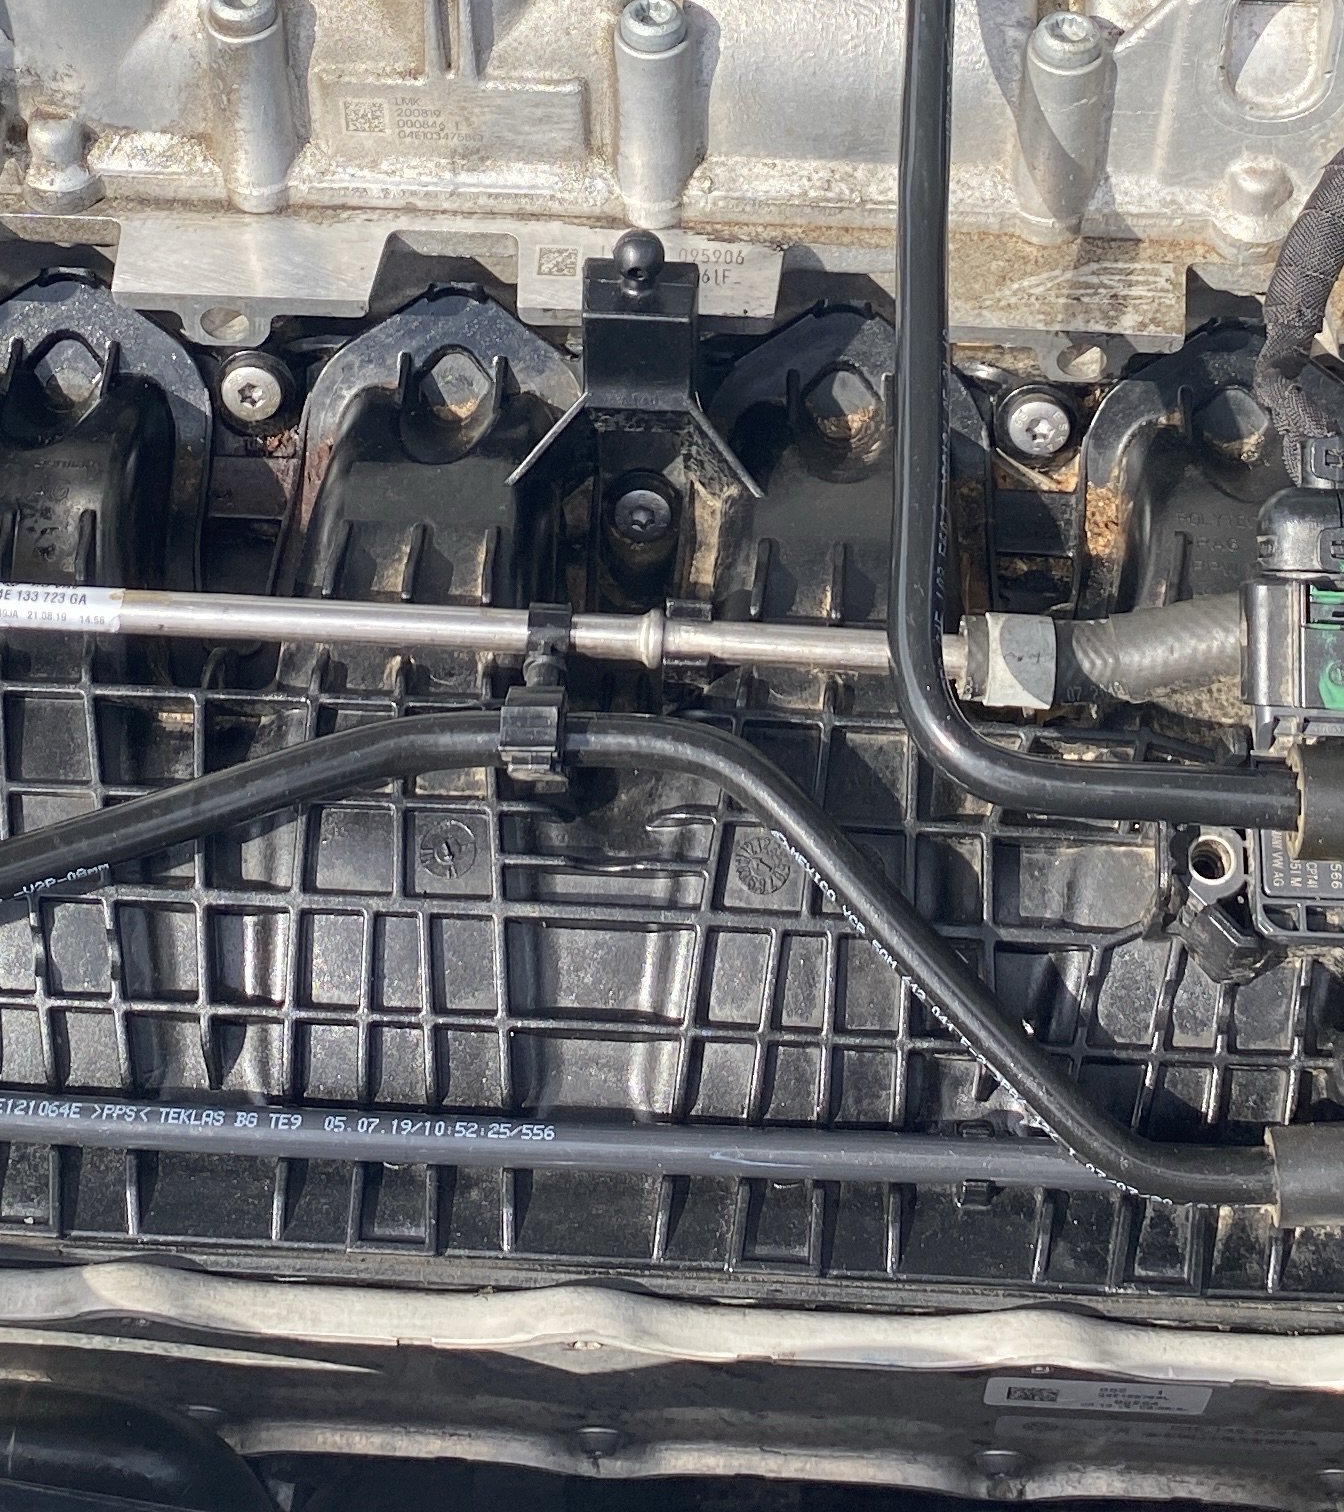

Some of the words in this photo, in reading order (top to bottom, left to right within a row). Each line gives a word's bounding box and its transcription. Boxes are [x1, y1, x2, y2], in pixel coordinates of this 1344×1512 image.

[678, 248, 744, 265] 095906
[17, 590, 37, 601] 133
[43, 592, 65, 604] 723
[69, 593, 86, 605] GA
[1272, 852, 1282, 868] VW
[1272, 871, 1283, 886] AG
[91, 1104, 149, 1123] >PPS<
[158, 1107, 227, 1127] TEKLAS
[233, 1111, 259, 1128] BG
[268, 1113, 302, 1130] TE9
